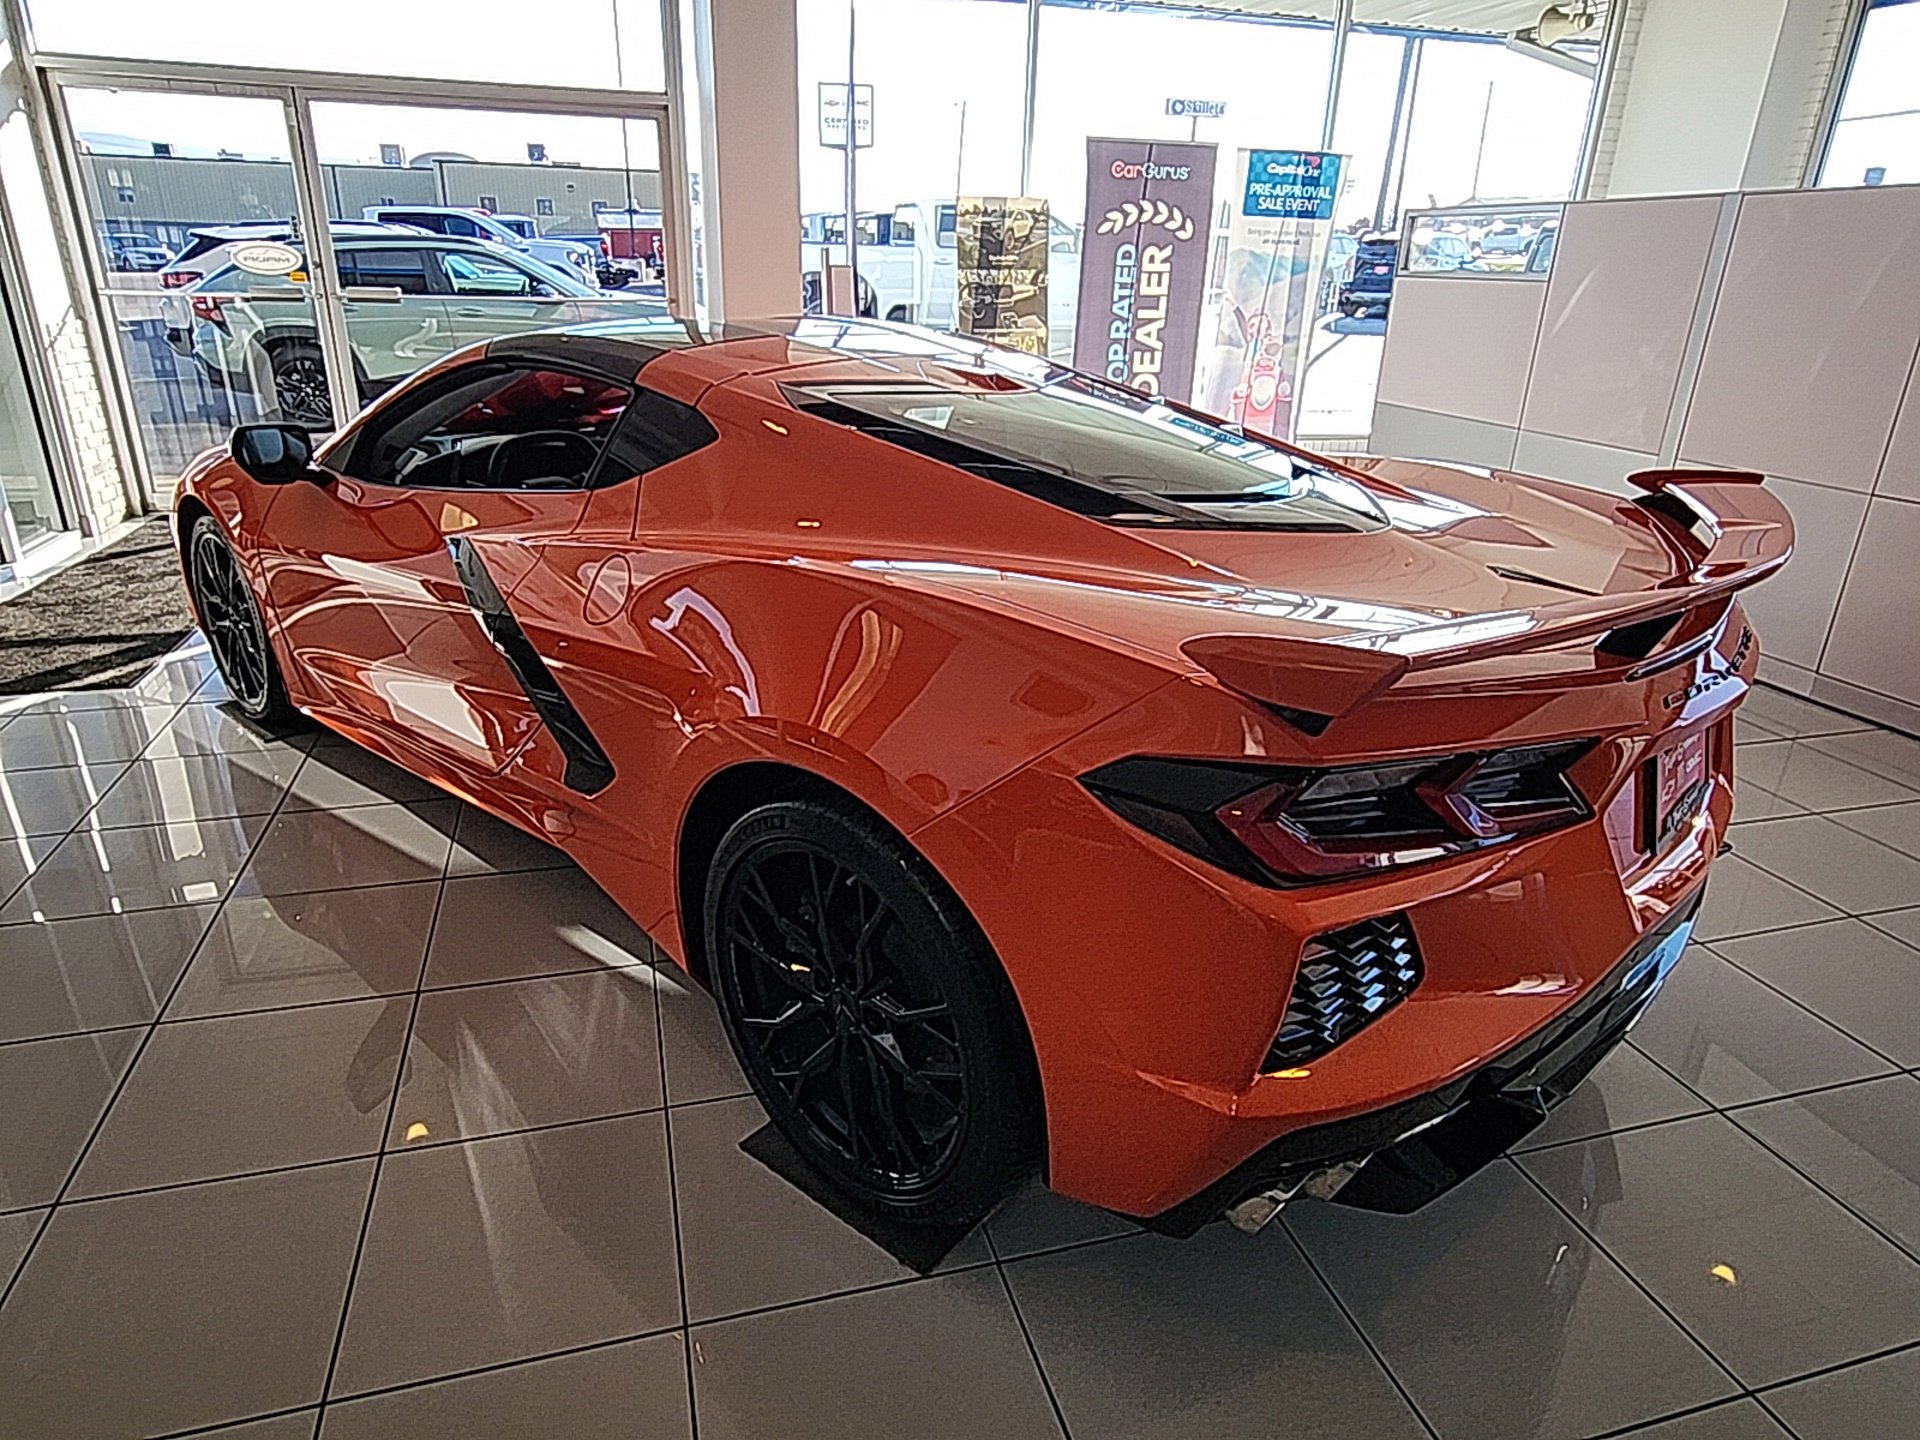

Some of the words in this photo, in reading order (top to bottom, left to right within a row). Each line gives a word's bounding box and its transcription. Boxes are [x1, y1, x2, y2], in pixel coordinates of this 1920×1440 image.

[1185, 100, 1225, 115] Skillets
[824, 117, 869, 125] CERTED
[1111, 161, 1192, 179] CarGurus
[1249, 183, 1332, 199] PRE-APPROVAL
[1258, 197, 1284, 210] SALE
[1285, 198, 1321, 211] EVENT
[1109, 243, 1137, 339] RATED
[1131, 244, 1174, 395] DEALER
[1106, 343, 1130, 385] OP
[1663, 626, 1752, 709] CORVETTE
